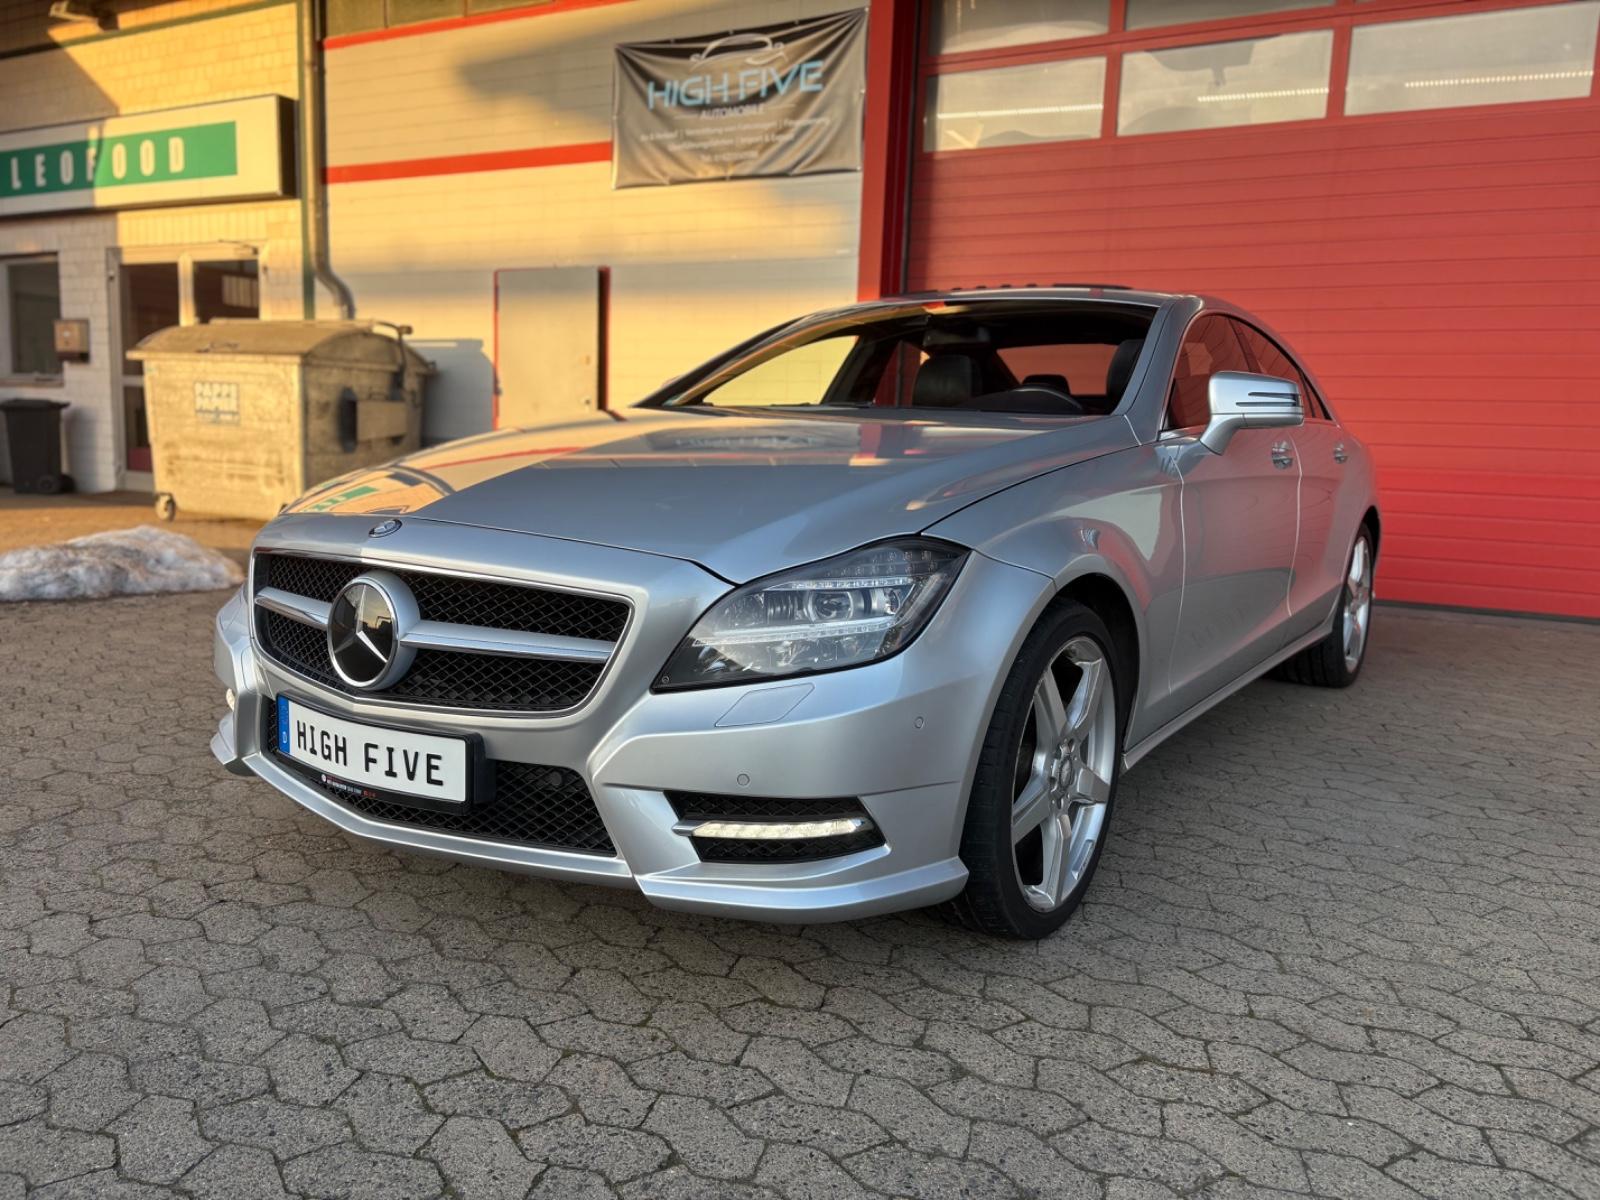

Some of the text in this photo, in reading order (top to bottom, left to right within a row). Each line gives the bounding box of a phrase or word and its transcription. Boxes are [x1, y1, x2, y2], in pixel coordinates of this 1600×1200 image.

[647, 61, 823, 109] HIGH FIVE
[701, 103, 764, 119] AUTOMOBILE
[11, 136, 185, 190] LEOFOOD
[297, 719, 348, 767] HIGH
[364, 742, 444, 787] FIVE
